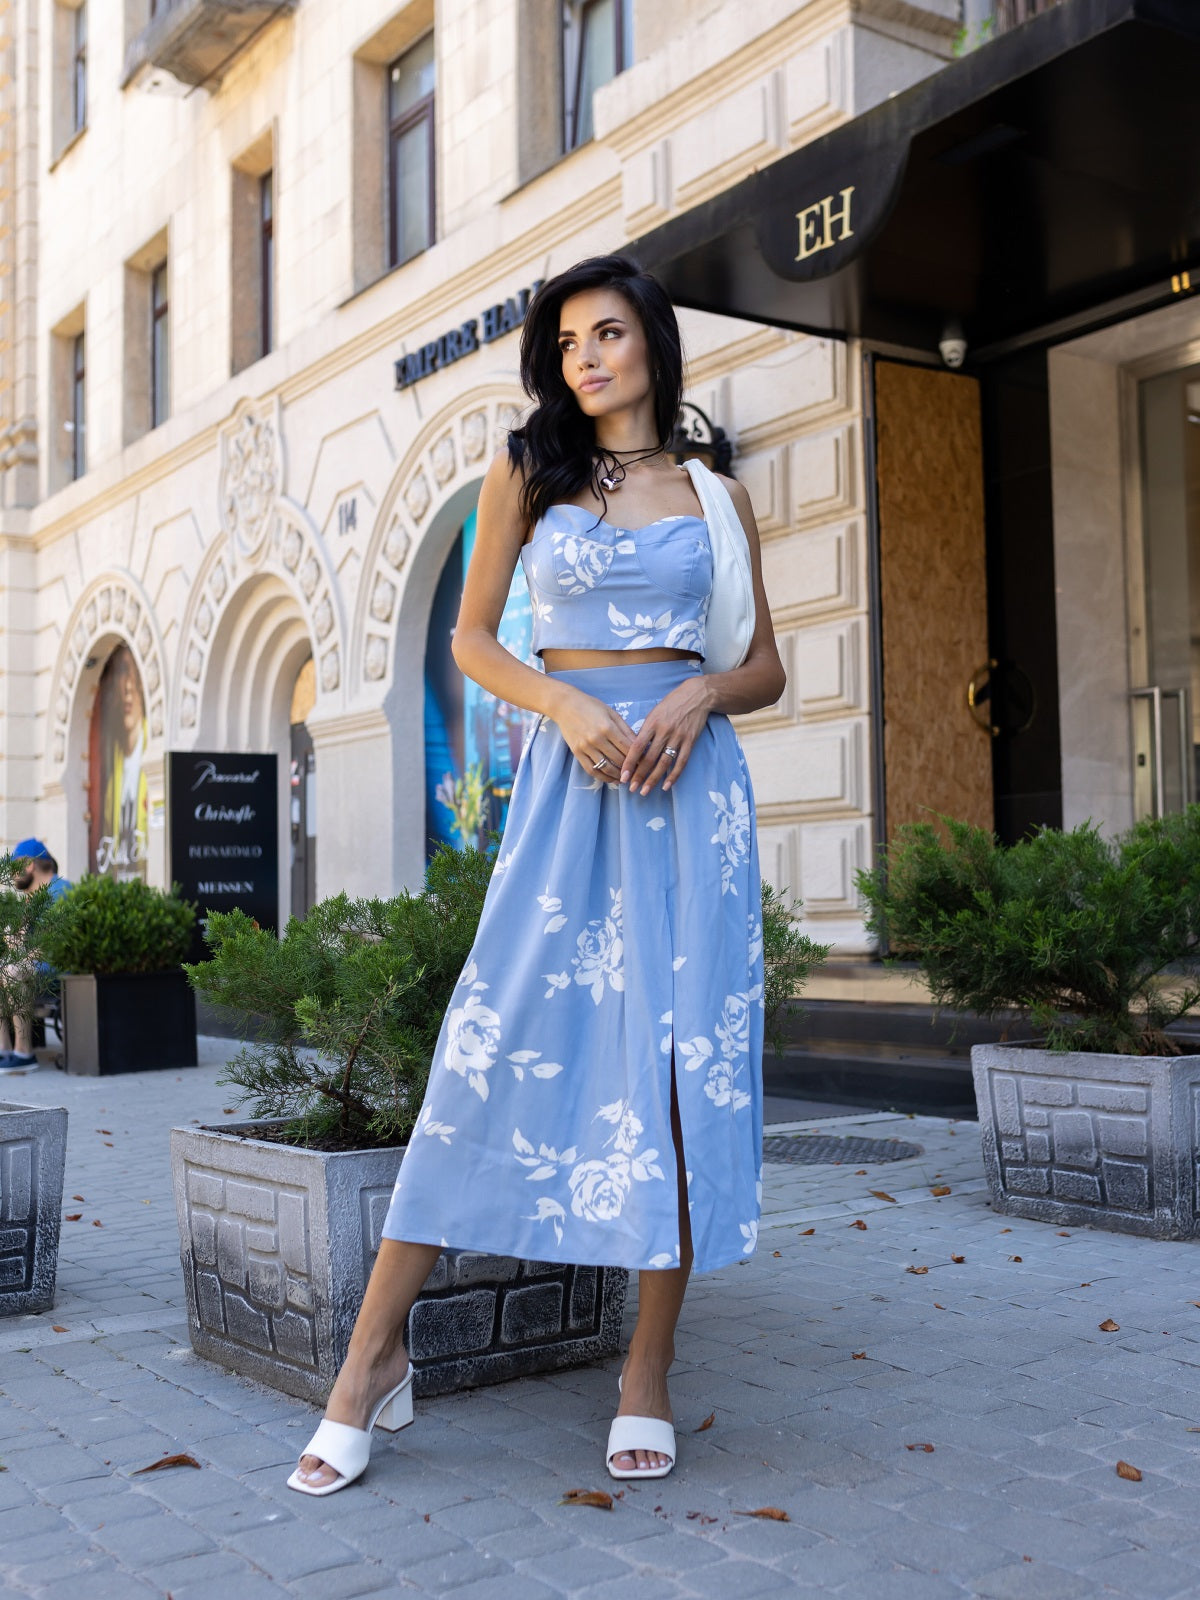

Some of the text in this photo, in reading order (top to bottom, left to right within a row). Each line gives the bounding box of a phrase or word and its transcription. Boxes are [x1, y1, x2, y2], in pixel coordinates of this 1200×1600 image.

[794, 186, 855, 262] EH
[394, 319, 480, 391] EMPIRE
[197, 881, 255, 894] MEISSEN
